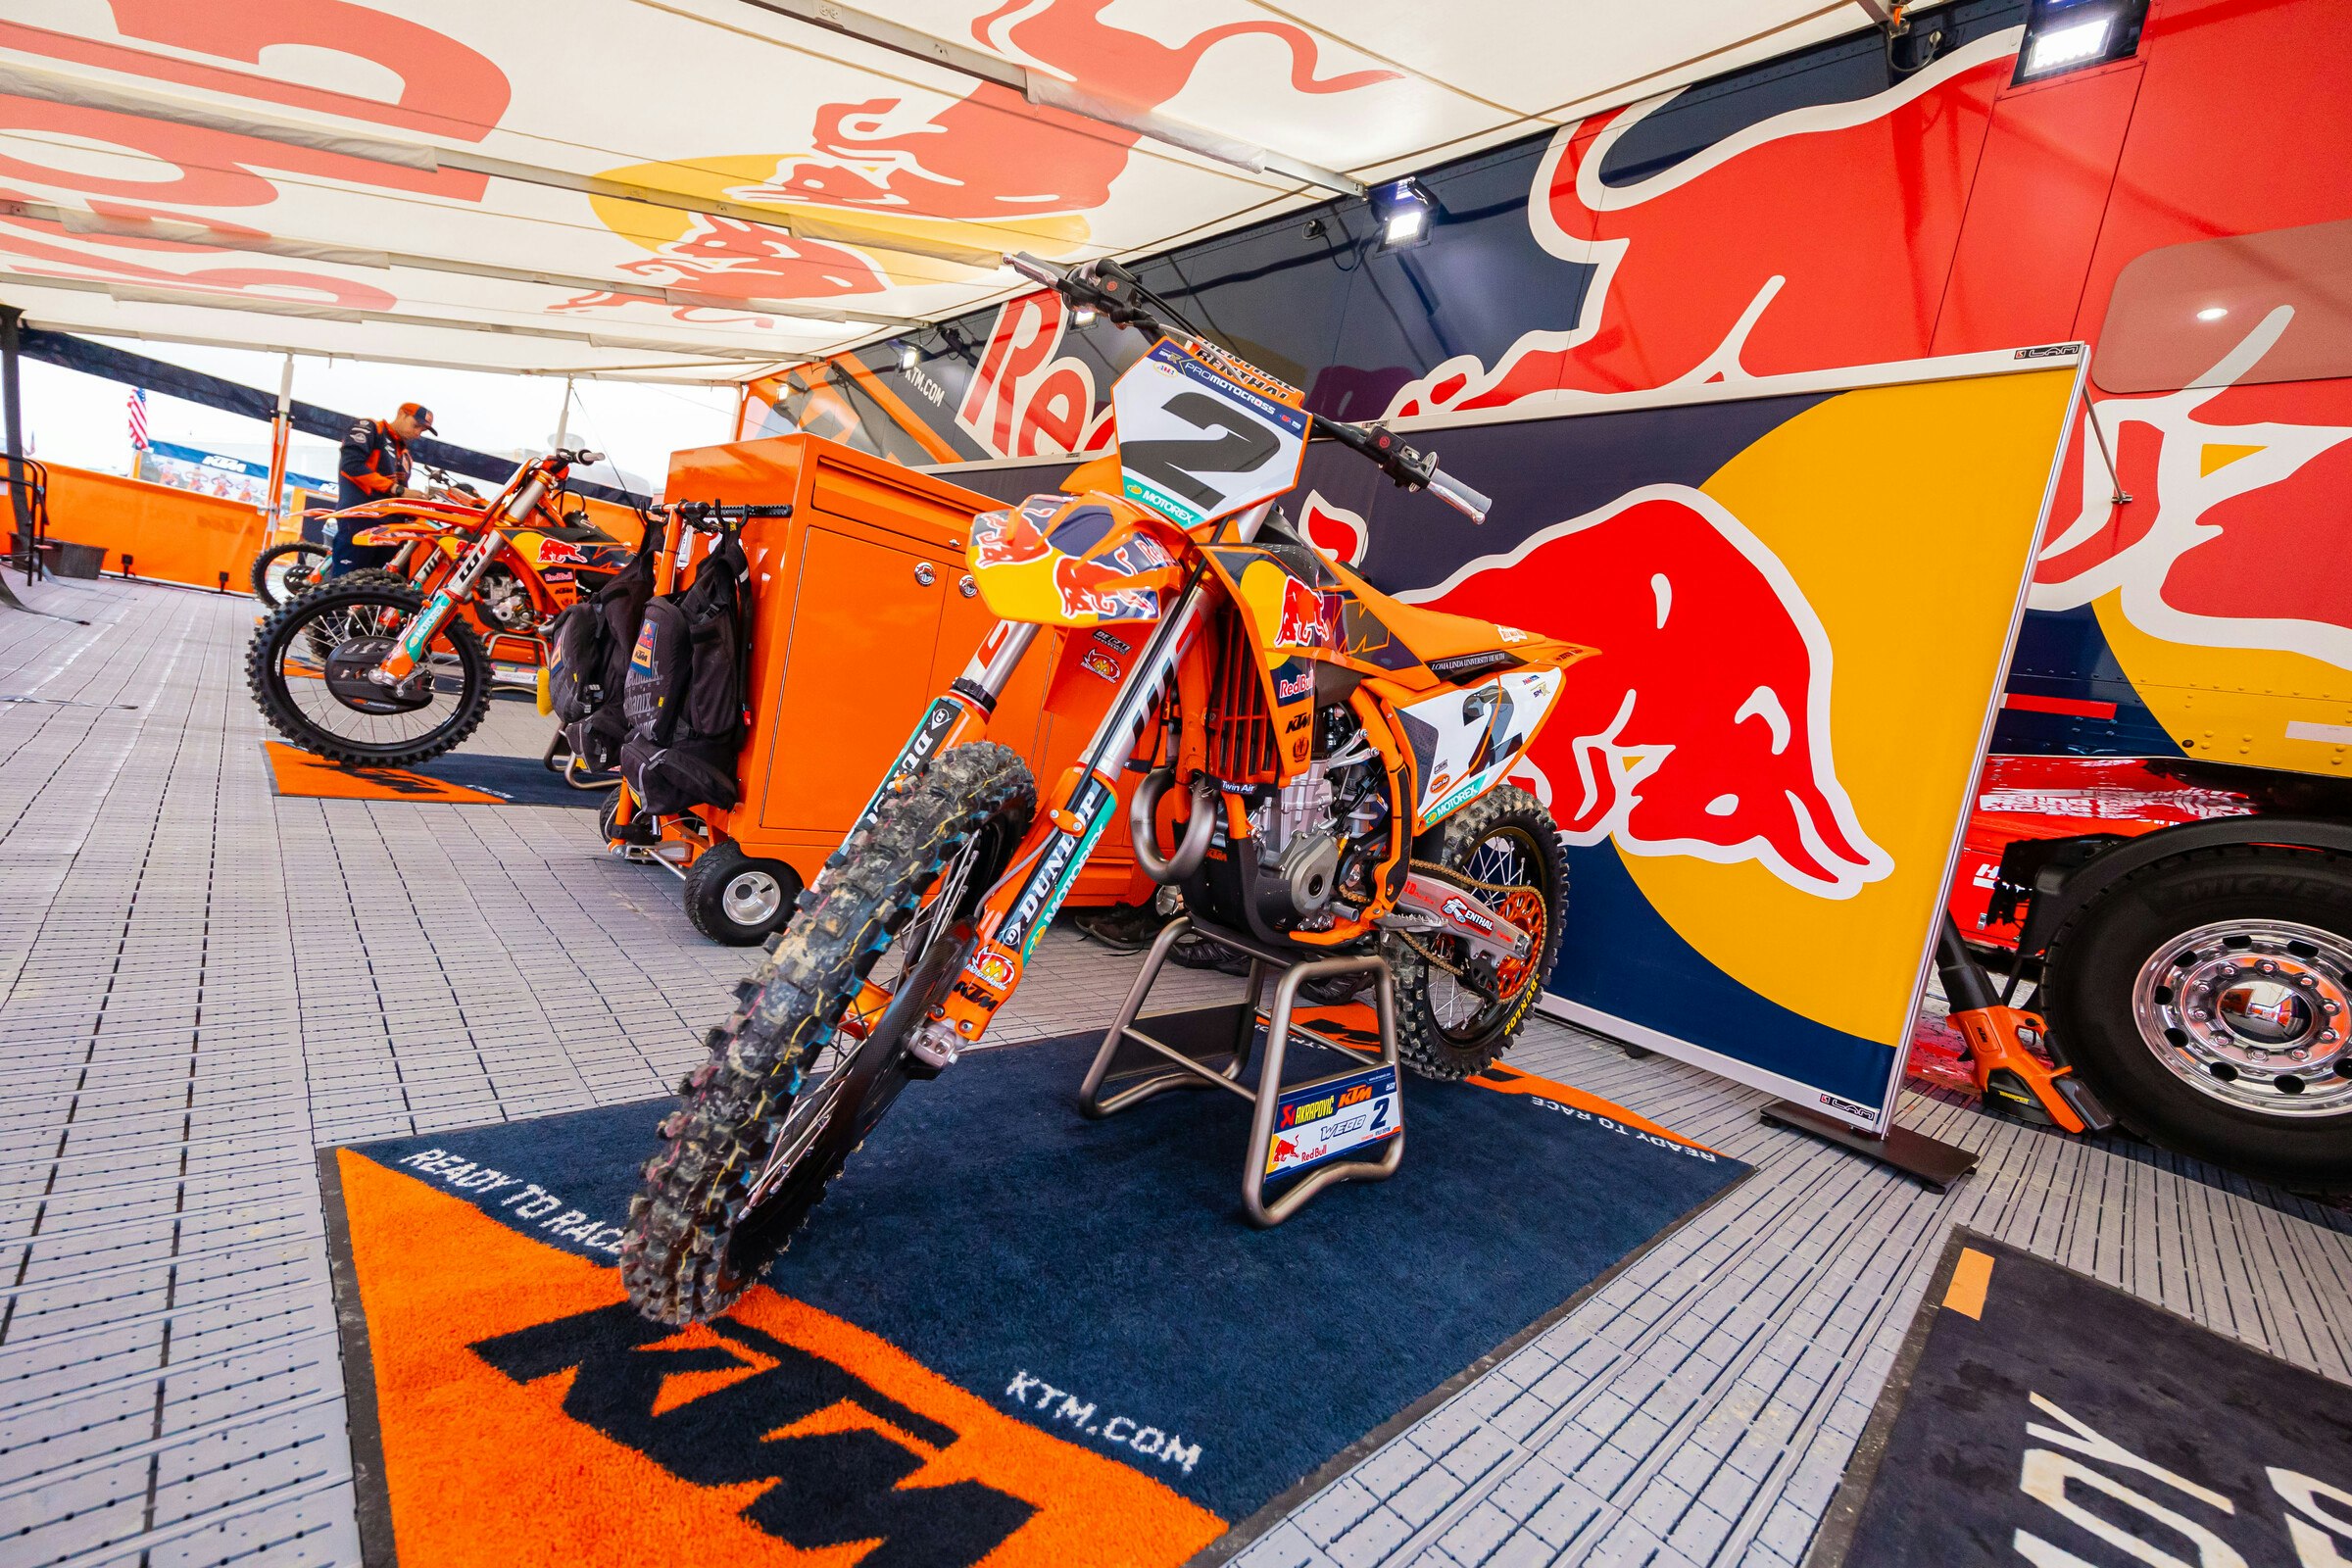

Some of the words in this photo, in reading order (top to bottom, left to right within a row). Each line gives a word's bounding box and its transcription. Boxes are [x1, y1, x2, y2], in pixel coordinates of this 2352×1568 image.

[202, 455, 247, 473] KTM
[1119, 392, 1282, 512] 2
[1143, 489, 1196, 526] MOTOREX
[416, 604, 446, 639] MOTOREX
[1432, 662, 1448, 671] LOMA
[1449, 660, 1464, 669] LINDA
[1464, 656, 1489, 668] UNIVERSITY
[1489, 653, 1505, 663] HEALTH
[1285, 711, 1311, 734] KTM
[1462, 684, 1523, 778] 2
[1221, 780, 1239, 792] Twin
[1240, 783, 1257, 794] Air
[1437, 785, 1478, 816] MOTOREX
[1018, 791, 1098, 923] DUNLP
[1044, 824, 1104, 925] MOTOREX
[953, 980, 1000, 1012] KTM
[1338, 1084, 1373, 1108] KTM
[1529, 1096, 1592, 1121] RACE
[1320, 1114, 1366, 1142] WEBB
[1369, 1097, 1390, 1131] 2
[1597, 1117, 1629, 1136] TO
[1301, 1148, 1314, 1162] Red
[1314, 1145, 1327, 1159] Bull
[1636, 1132, 1717, 1163] READY
[399, 1148, 523, 1194] READY
[501, 1184, 563, 1220] TO
[1004, 1369, 1202, 1475] KTM.COM
